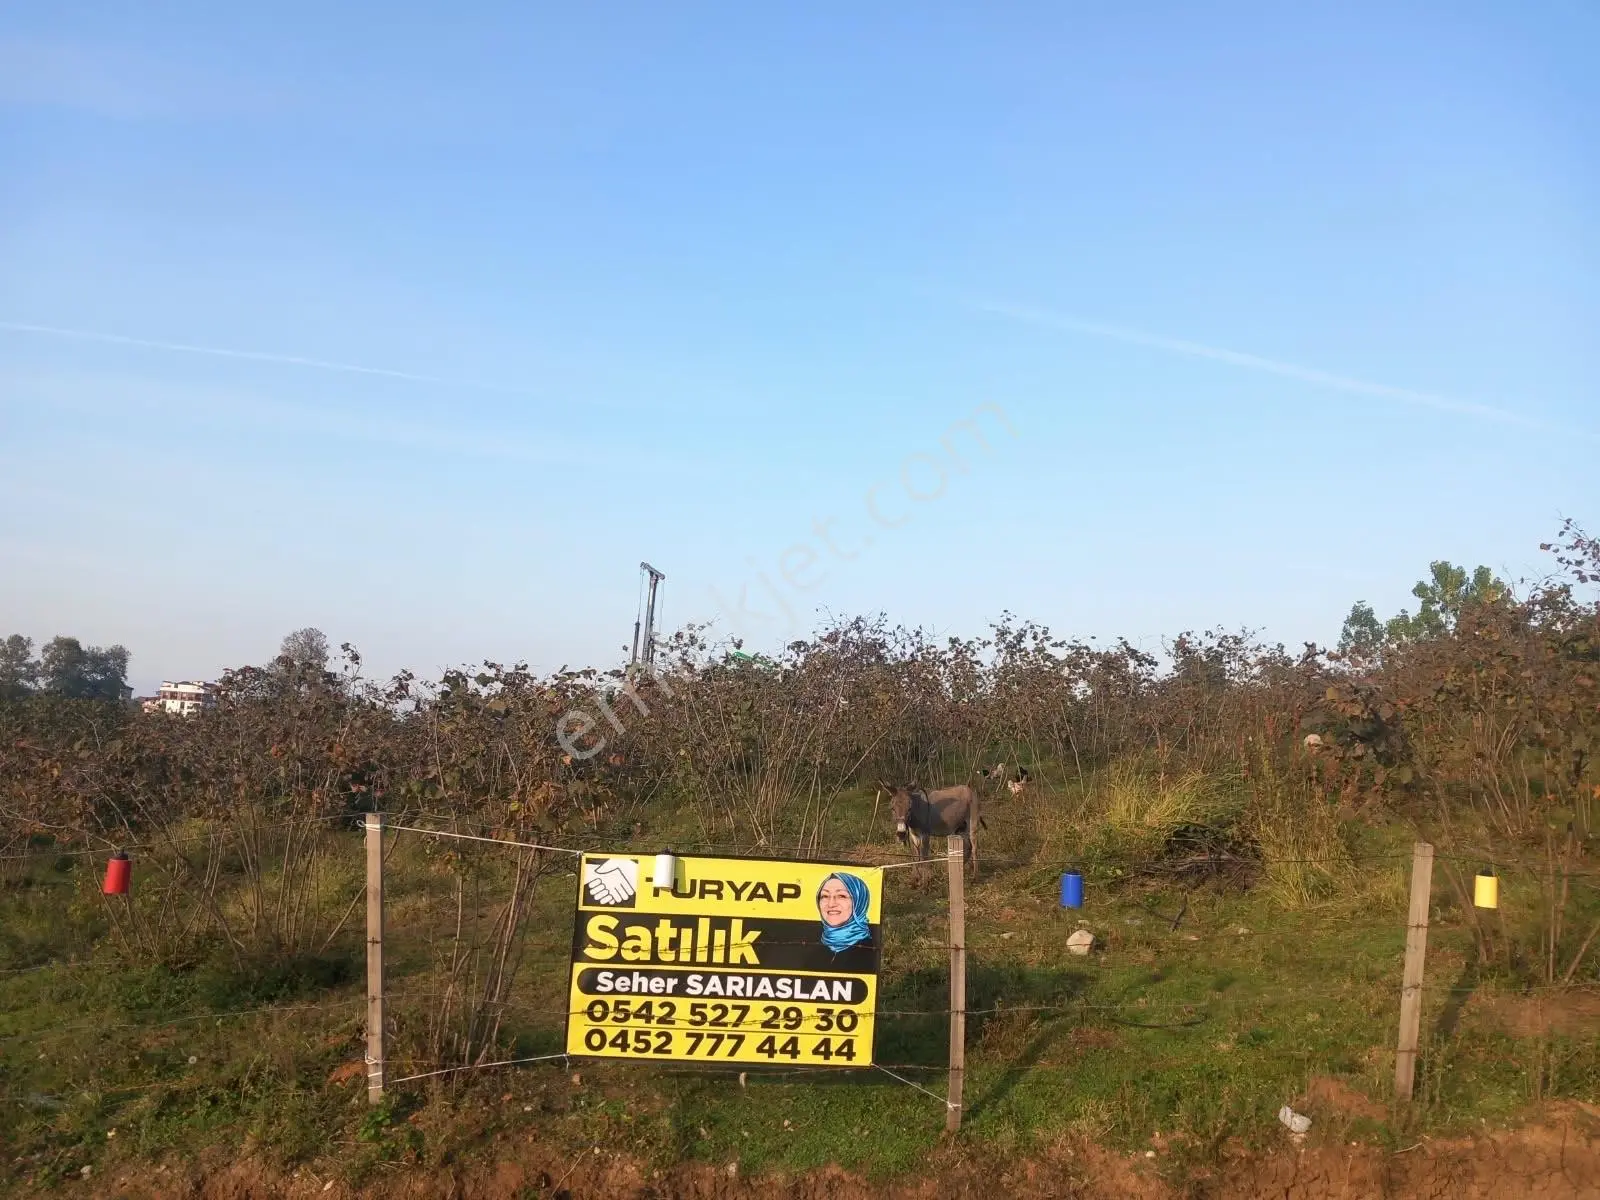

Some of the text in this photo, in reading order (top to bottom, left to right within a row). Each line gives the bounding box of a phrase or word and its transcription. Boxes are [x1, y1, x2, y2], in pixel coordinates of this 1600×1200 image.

[583, 914, 761, 965] Satılık
[596, 971, 853, 1001] Seher SARIASLAN
[586, 999, 858, 1033] 0542 527 29 30
[584, 1028, 856, 1062] 0452 777 44 44
